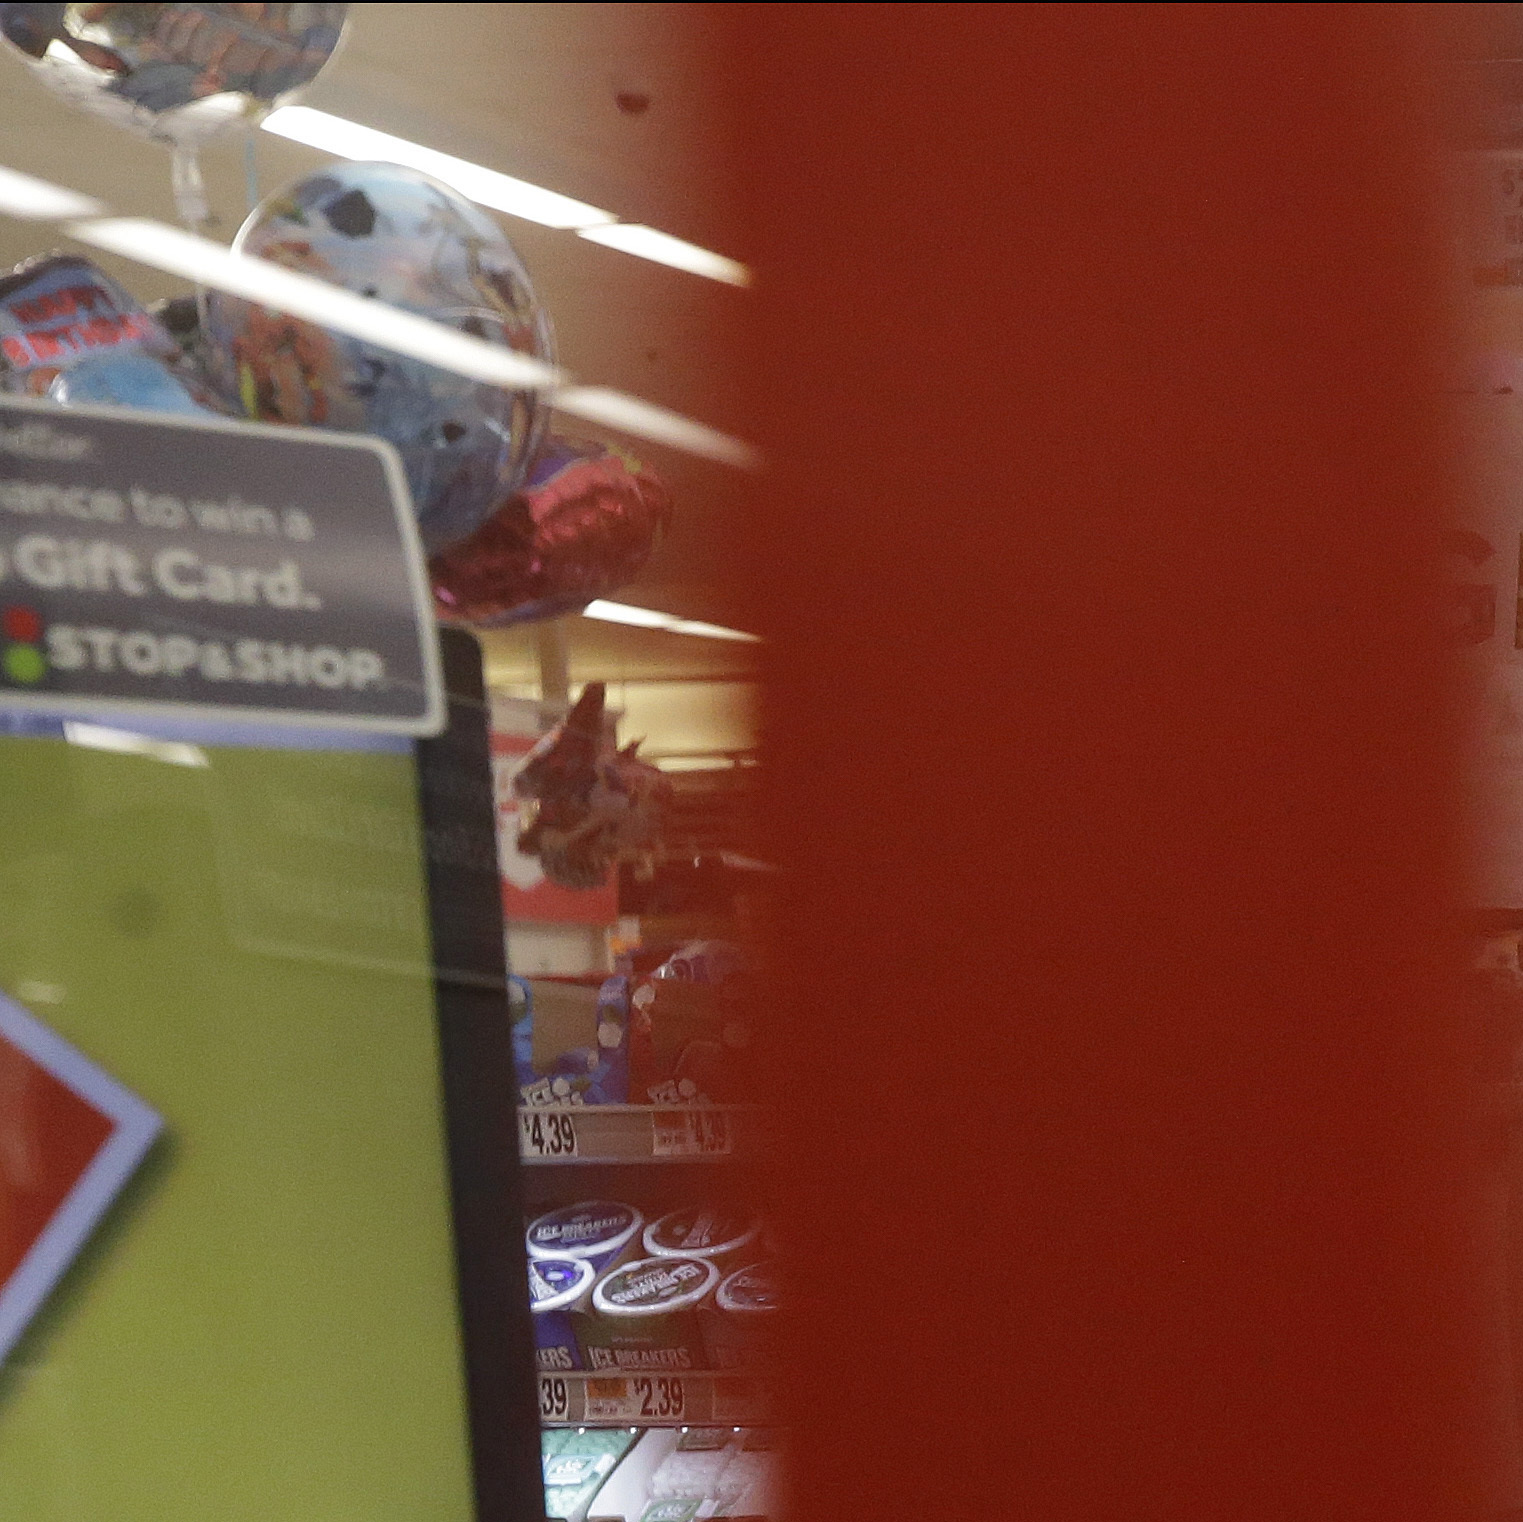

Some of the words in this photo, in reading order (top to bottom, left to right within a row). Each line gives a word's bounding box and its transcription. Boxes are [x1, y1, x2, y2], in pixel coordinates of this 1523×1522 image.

[12, 533, 146, 598] Gift
[153, 547, 323, 611] Card.
[524, 1113, 576, 1155] $4.39
[541, 1377, 568, 1416] 39
[633, 1377, 685, 1417] $2.39
